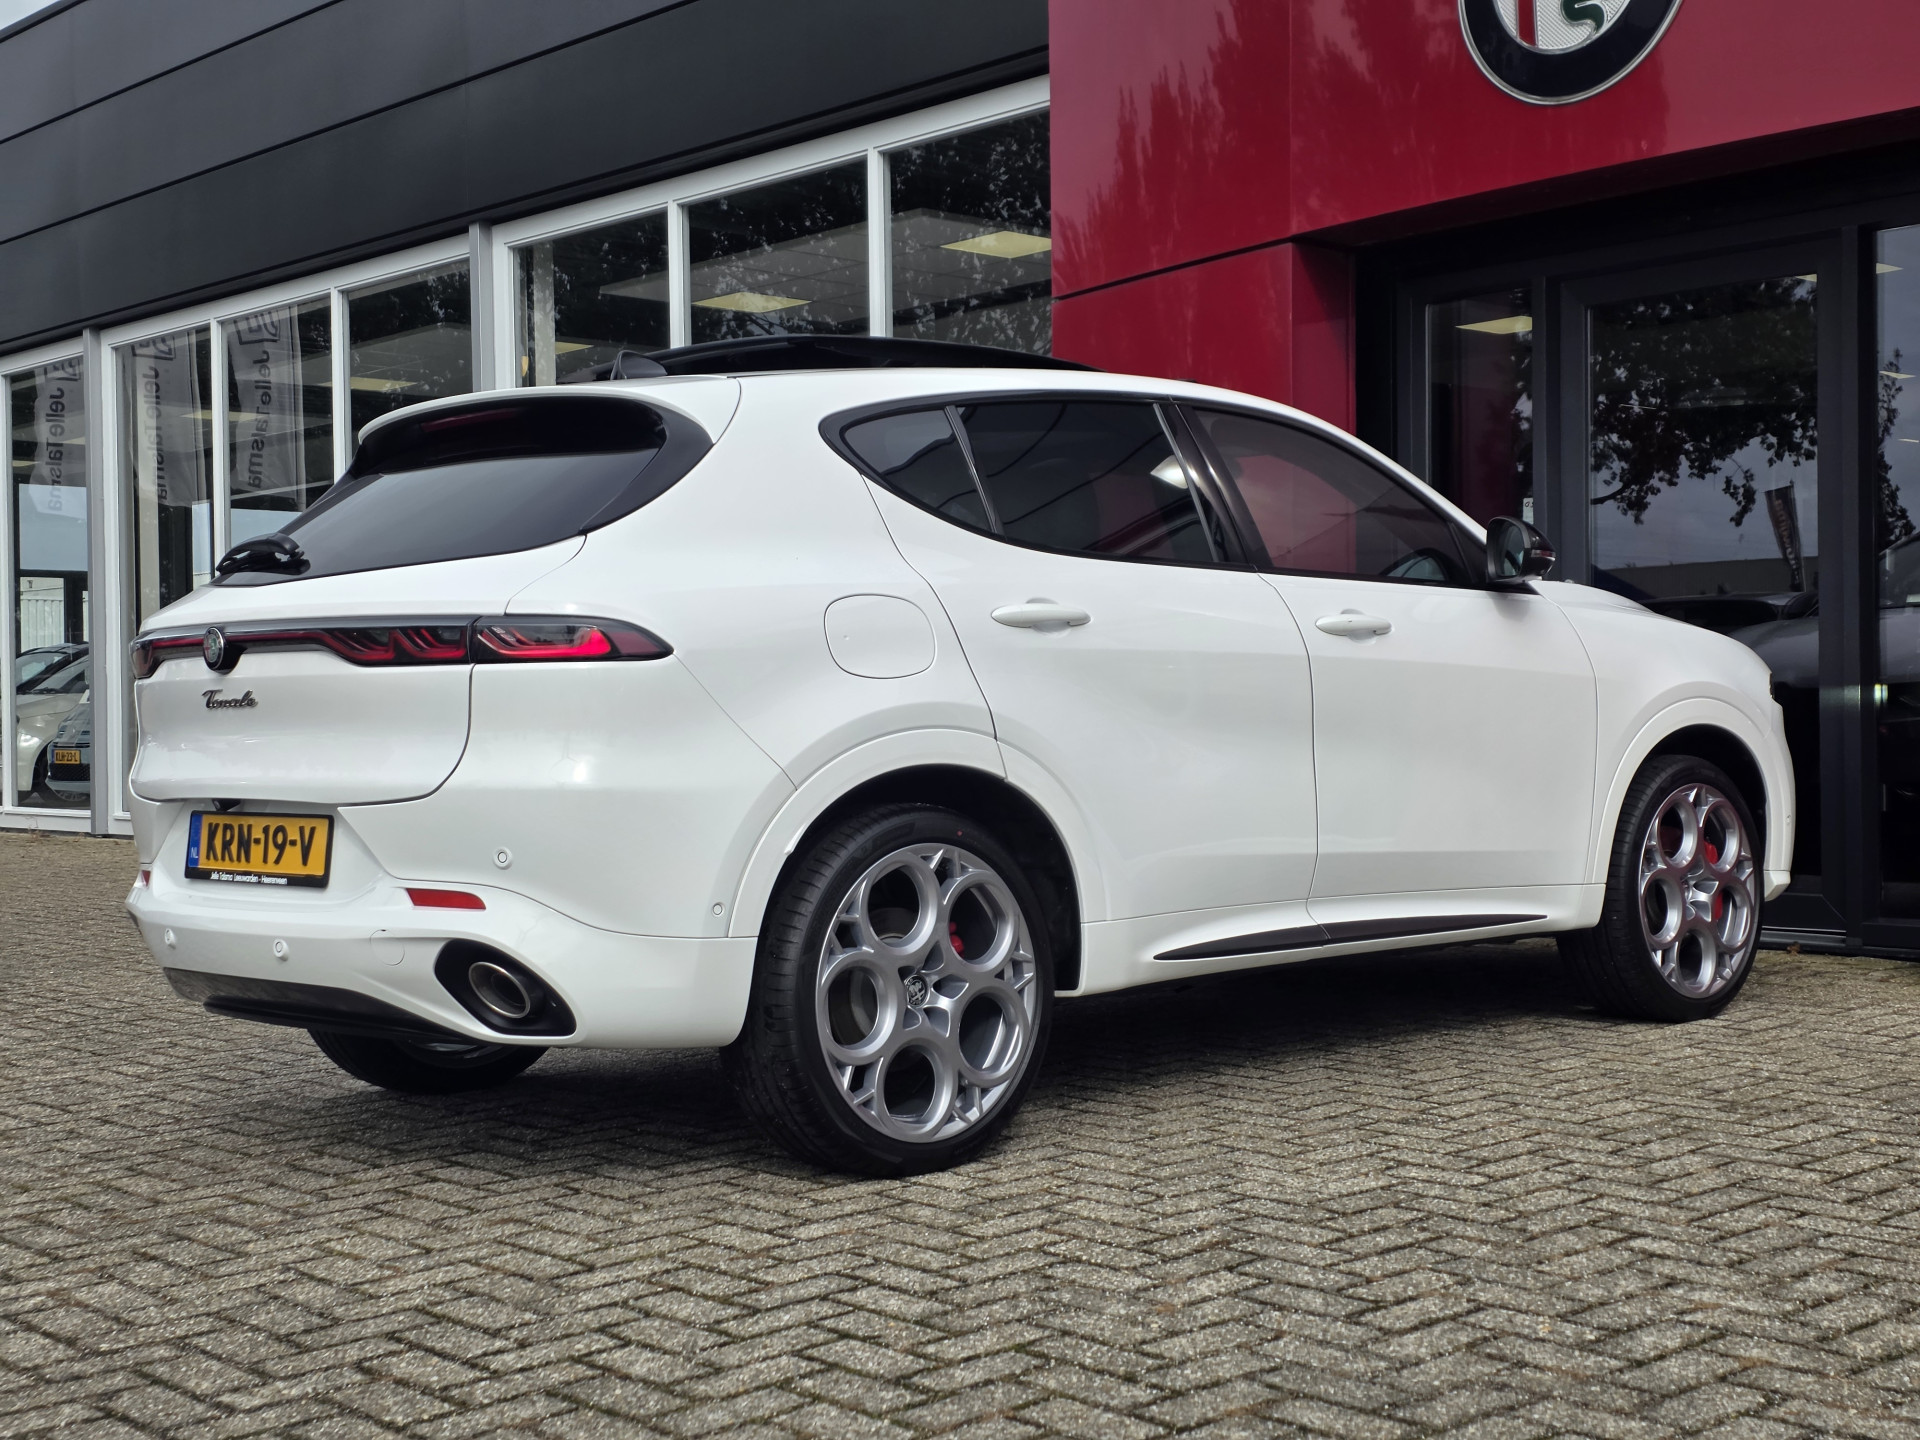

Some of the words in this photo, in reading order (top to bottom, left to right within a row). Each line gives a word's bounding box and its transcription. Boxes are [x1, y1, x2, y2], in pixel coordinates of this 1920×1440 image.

[201, 688, 259, 709] Tonale
[190, 847, 199, 859] NL
[205, 822, 316, 867] KRN-19-V
